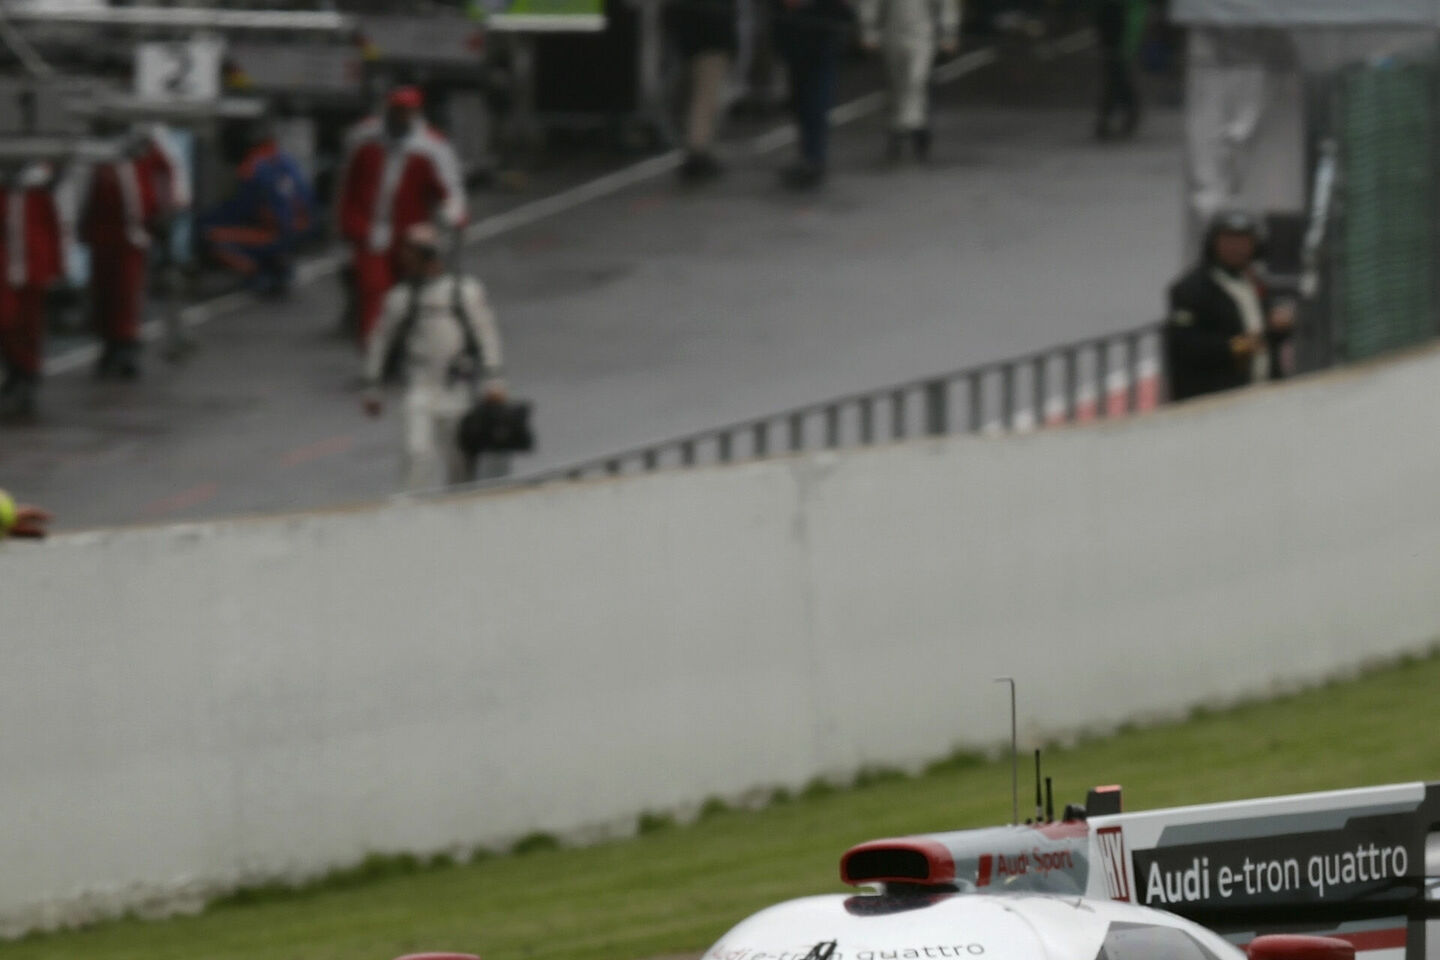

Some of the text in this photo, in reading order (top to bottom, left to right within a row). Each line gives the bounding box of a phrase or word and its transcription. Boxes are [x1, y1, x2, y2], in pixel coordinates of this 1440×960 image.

[1033, 847, 1073, 878] Sport
[1146, 843, 1408, 904] Audi e-tron quattro
